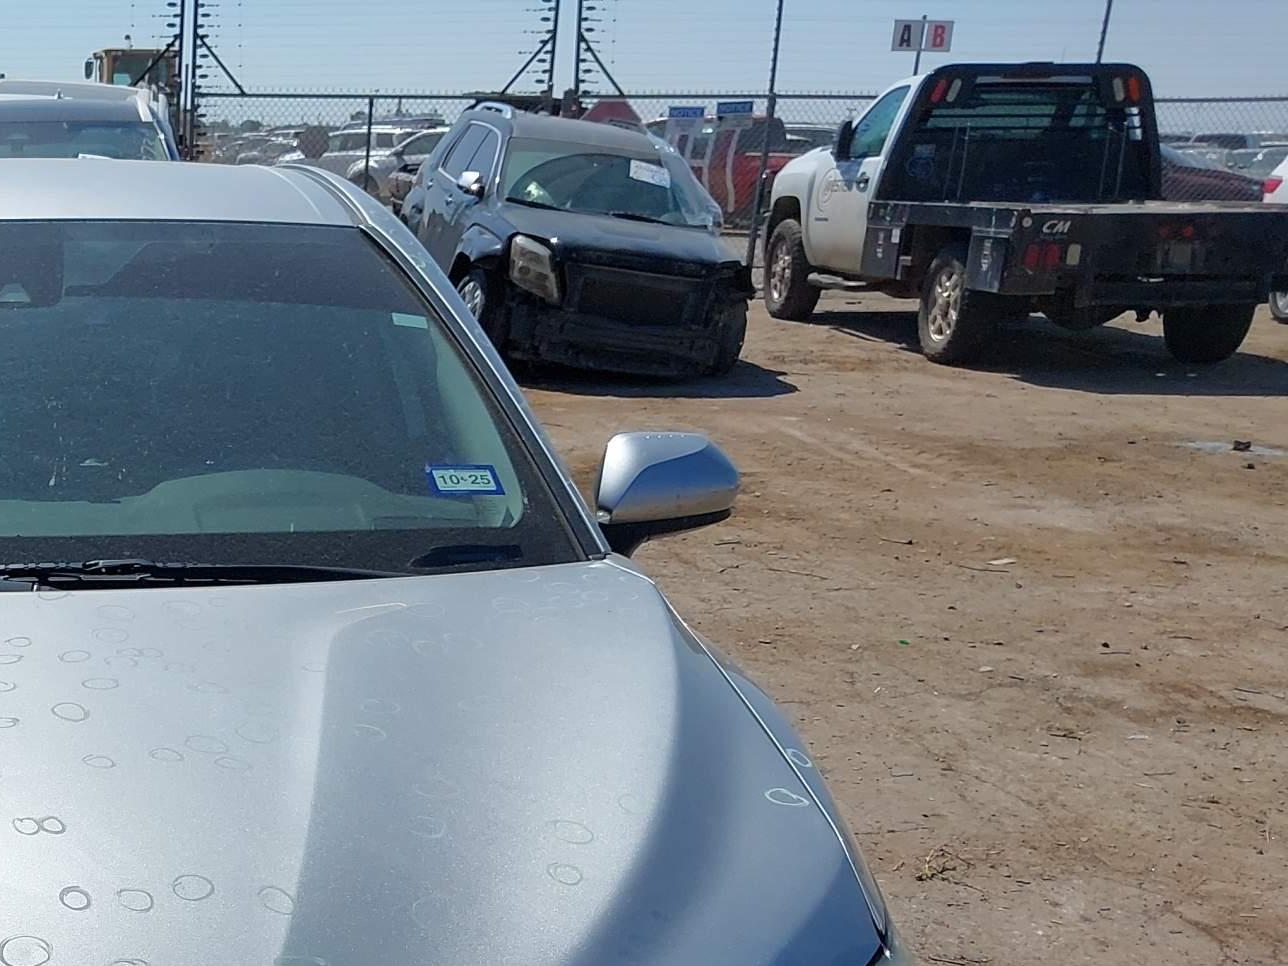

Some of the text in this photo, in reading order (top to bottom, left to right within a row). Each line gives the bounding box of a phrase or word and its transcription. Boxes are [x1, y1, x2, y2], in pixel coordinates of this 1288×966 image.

[898, 24, 912, 48] A
[931, 24, 946, 48] B
[1042, 220, 1072, 233] CM
